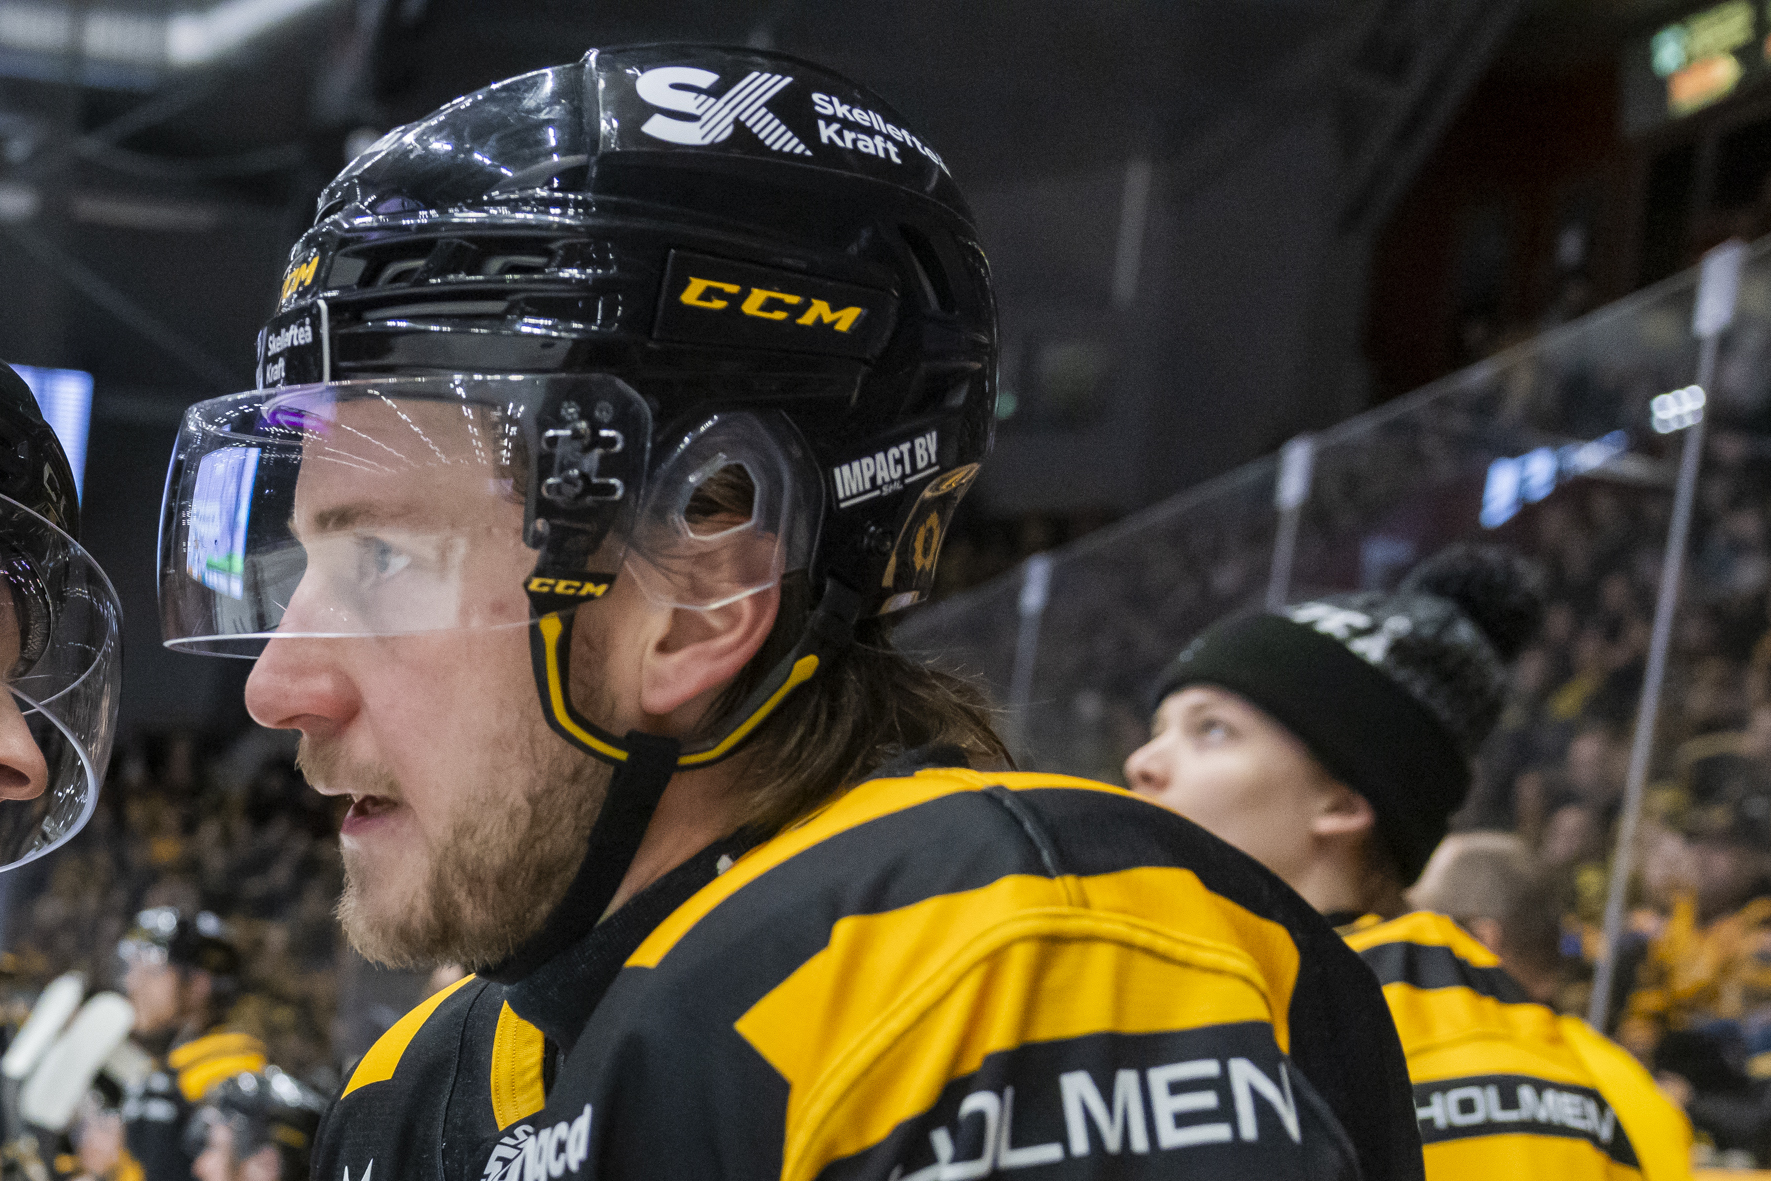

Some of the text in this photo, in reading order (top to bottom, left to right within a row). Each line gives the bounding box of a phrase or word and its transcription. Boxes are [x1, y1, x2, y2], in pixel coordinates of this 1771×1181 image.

[817, 119, 902, 165] Kraft
[680, 276, 864, 333] CCM
[833, 430, 938, 500] IMPACT BY
[528, 577, 608, 597] CCM
